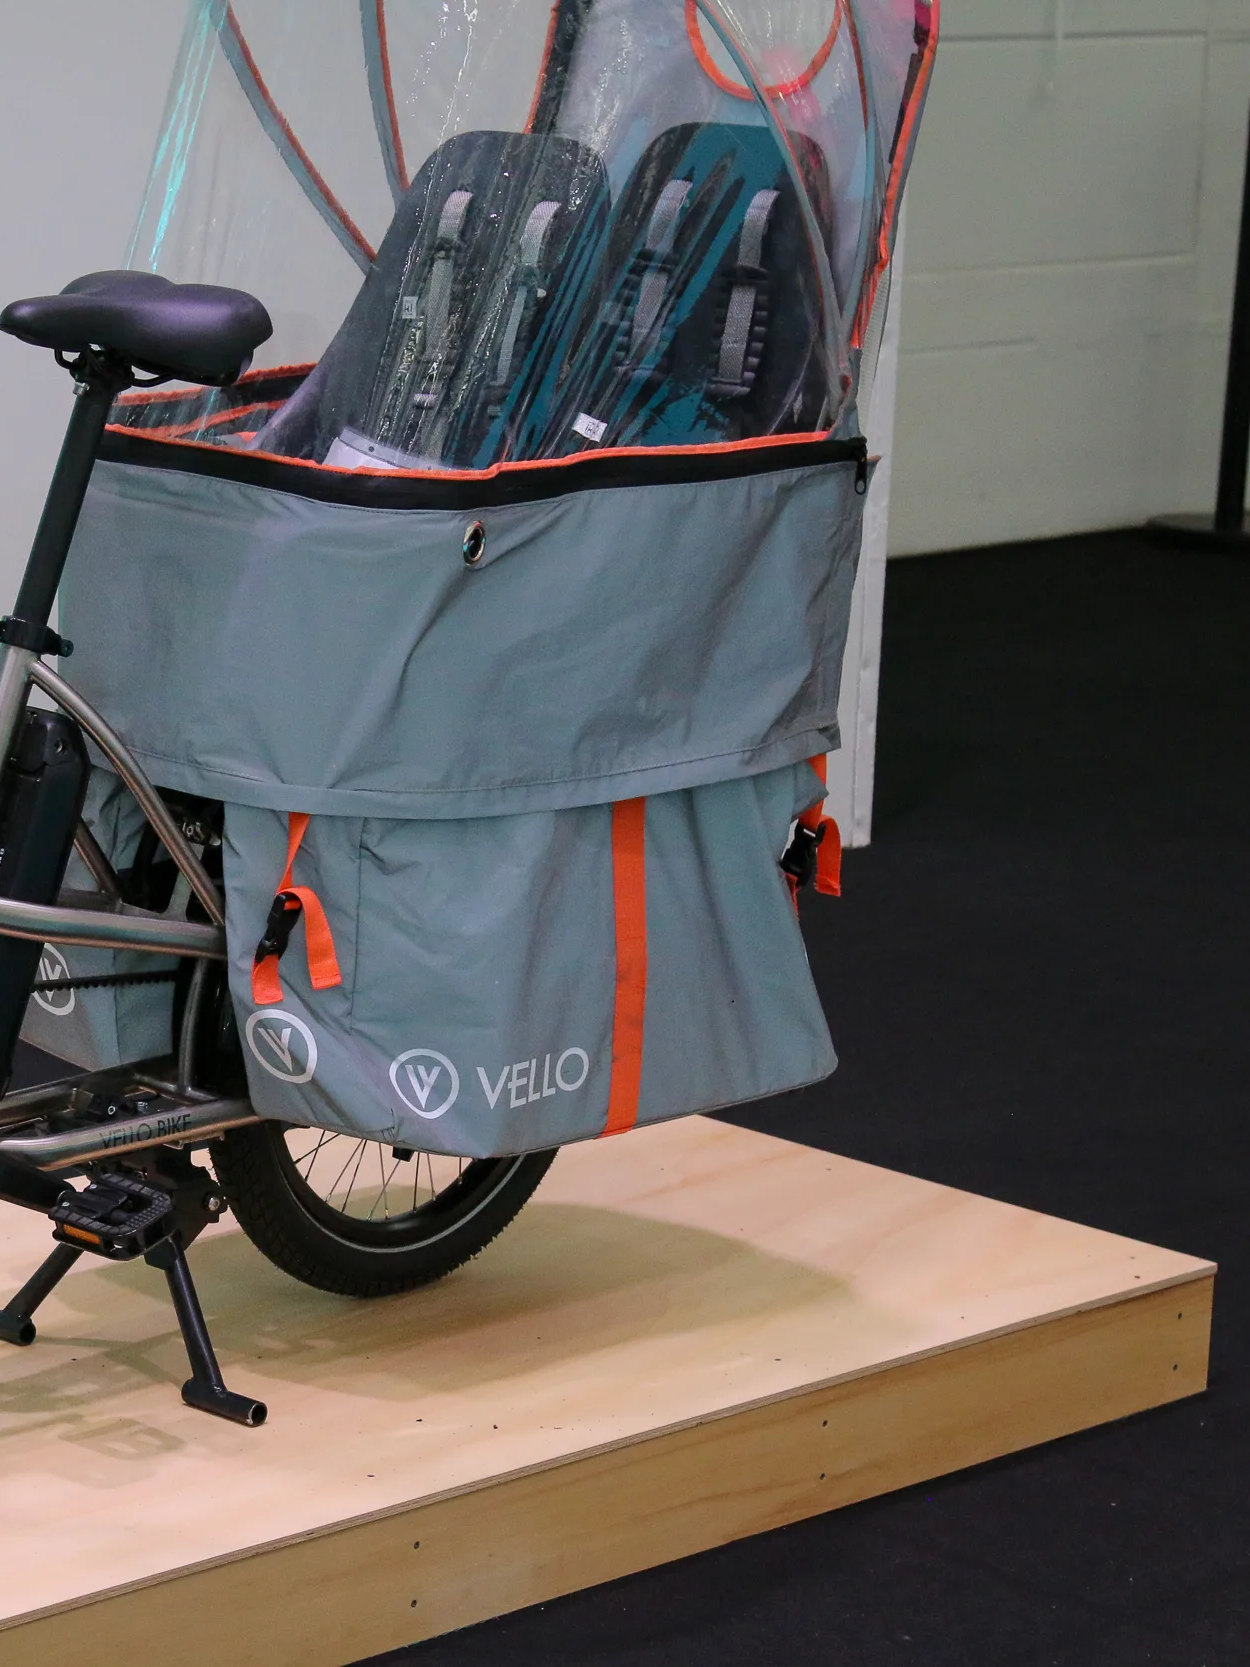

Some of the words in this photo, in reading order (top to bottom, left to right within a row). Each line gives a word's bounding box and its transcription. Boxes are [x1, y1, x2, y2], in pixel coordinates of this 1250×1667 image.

[476, 1047, 589, 1110] VELLO
[99, 1122, 152, 1149] VELLO
[157, 1114, 192, 1138] BIKE
